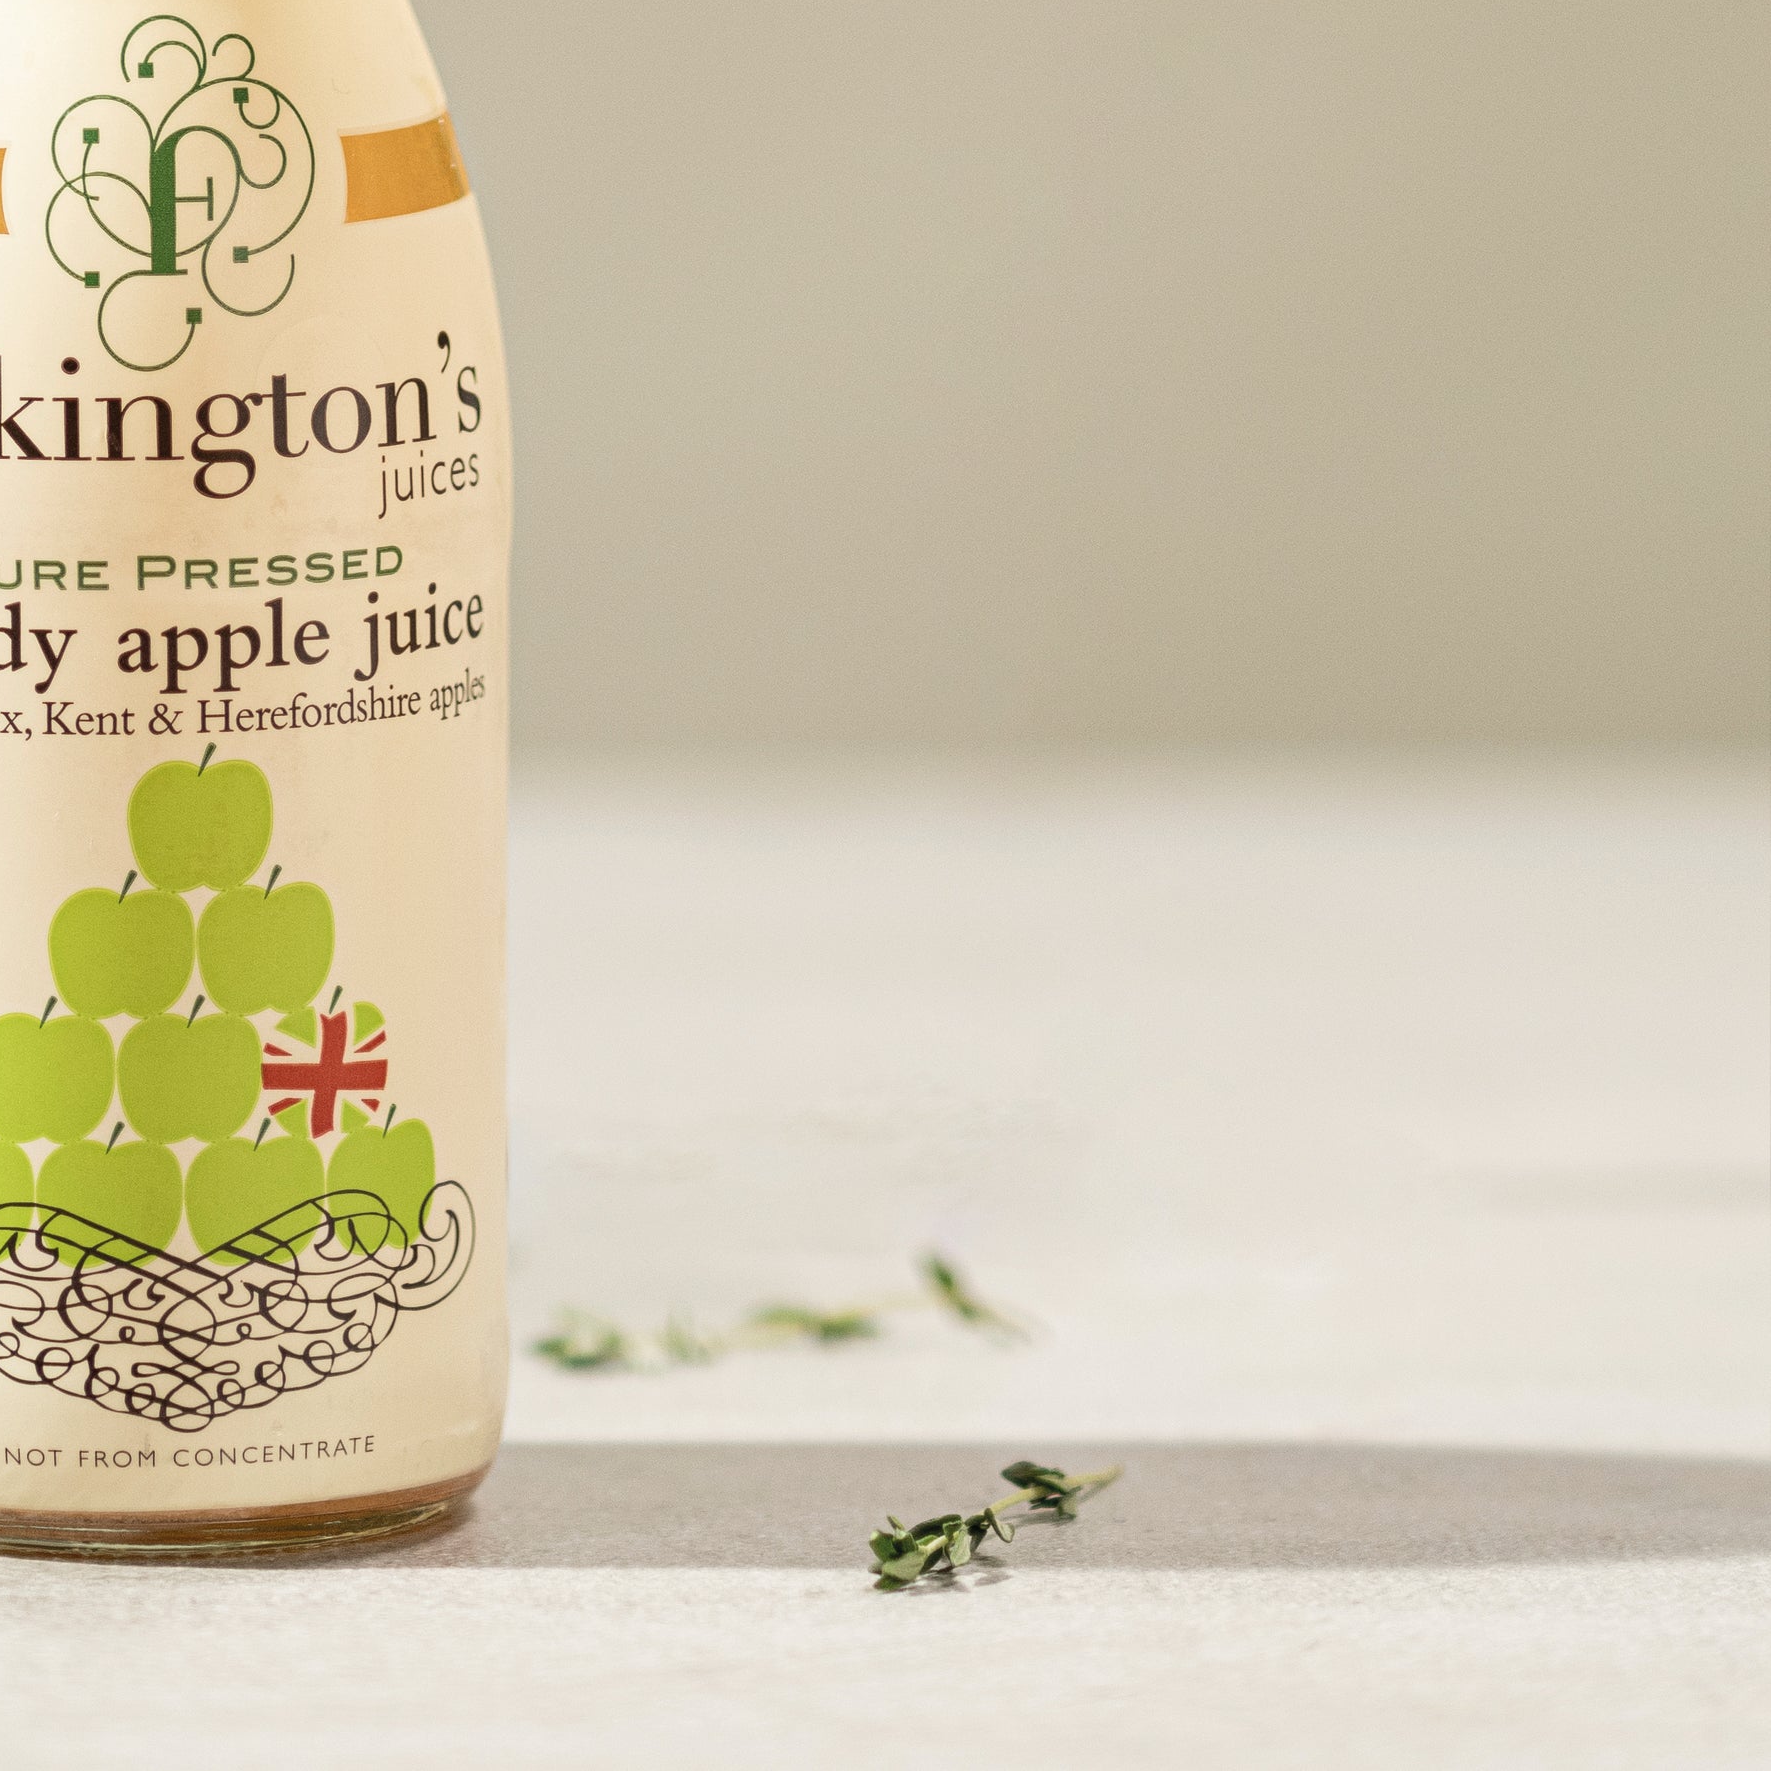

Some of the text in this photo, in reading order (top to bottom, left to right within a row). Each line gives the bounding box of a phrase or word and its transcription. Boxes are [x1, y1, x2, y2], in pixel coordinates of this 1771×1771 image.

[378, 451, 480, 519] juices
[117, 597, 331, 694] apple
[353, 582, 485, 682] juice
[42, 699, 135, 736] Kent
[148, 703, 183, 736] &
[196, 688, 422, 733] Herefordshire
[429, 668, 486, 721] apples
[4, 1435, 375, 1468] NOT FROM CONCENTRATE
